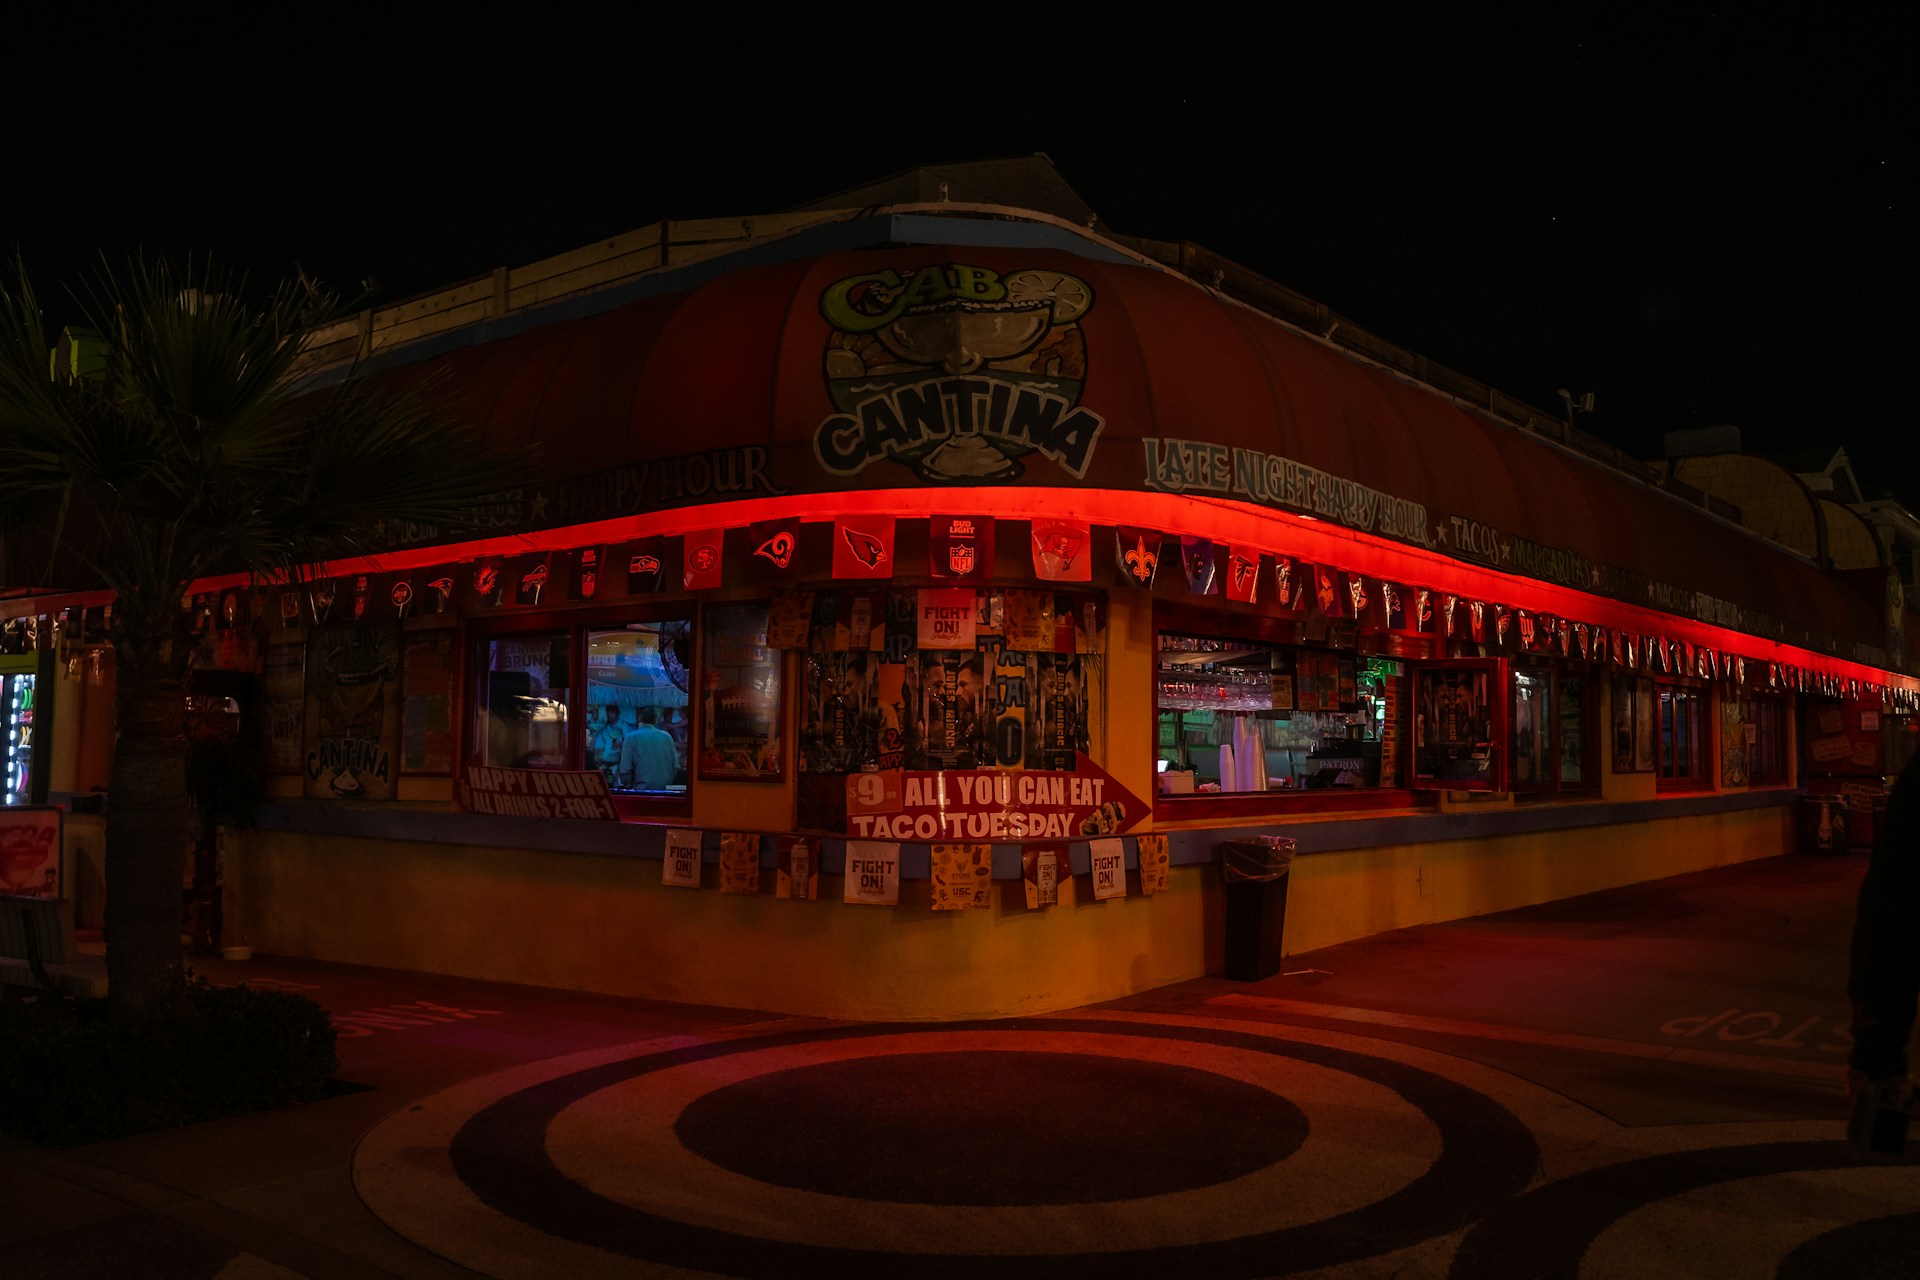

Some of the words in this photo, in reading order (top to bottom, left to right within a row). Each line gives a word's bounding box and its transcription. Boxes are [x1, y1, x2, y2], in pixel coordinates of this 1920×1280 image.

[814, 374, 1106, 480] CANTINA
[558, 463, 650, 518] HAPPY
[657, 446, 789, 501] HOUR
[949, 526, 975, 534] LIGHT
[1142, 437, 1230, 492] LATE
[1232, 447, 1316, 509] NIGHT
[1311, 471, 1379, 532] HAPPY
[1378, 492, 1436, 550] HOUR
[1450, 515, 1500, 565] TACOS
[1510, 536, 1591, 589] MARGARITAS
[1656, 580, 1689, 612] NACHOS
[952, 557, 972, 570] NFL
[924, 606, 971, 619] FIGHT
[934, 620, 960, 633] ON!
[1023, 630, 1038, 638] USC
[505, 654, 550, 668] BRUNC
[946, 670, 956, 702] JONES
[1057, 671, 1065, 702] JONES
[1057, 709, 1065, 746] MIOCIC
[305, 737, 389, 785] CANTINA
[468, 766, 530, 793] HAPPY
[531, 770, 605, 796] HOUR
[905, 777, 951, 806] ALL
[957, 776, 1011, 805] YOU
[1018, 776, 1064, 805] CAN
[1070, 778, 1104, 806] EAT
[472, 791, 494, 814] ALL
[494, 793, 551, 817] DRINKS
[550, 797, 615, 819] 2-FOR-1
[852, 814, 938, 839] TACO
[945, 812, 1076, 838] TUESDAY
[670, 846, 698, 860] FIGHT
[675, 860, 692, 873] ON!
[852, 860, 894, 874] FIGHT
[1094, 856, 1121, 871] FIGHT
[861, 875, 884, 888] ON!
[1098, 869, 1114, 884] ON!
[952, 887, 971, 896] USC
